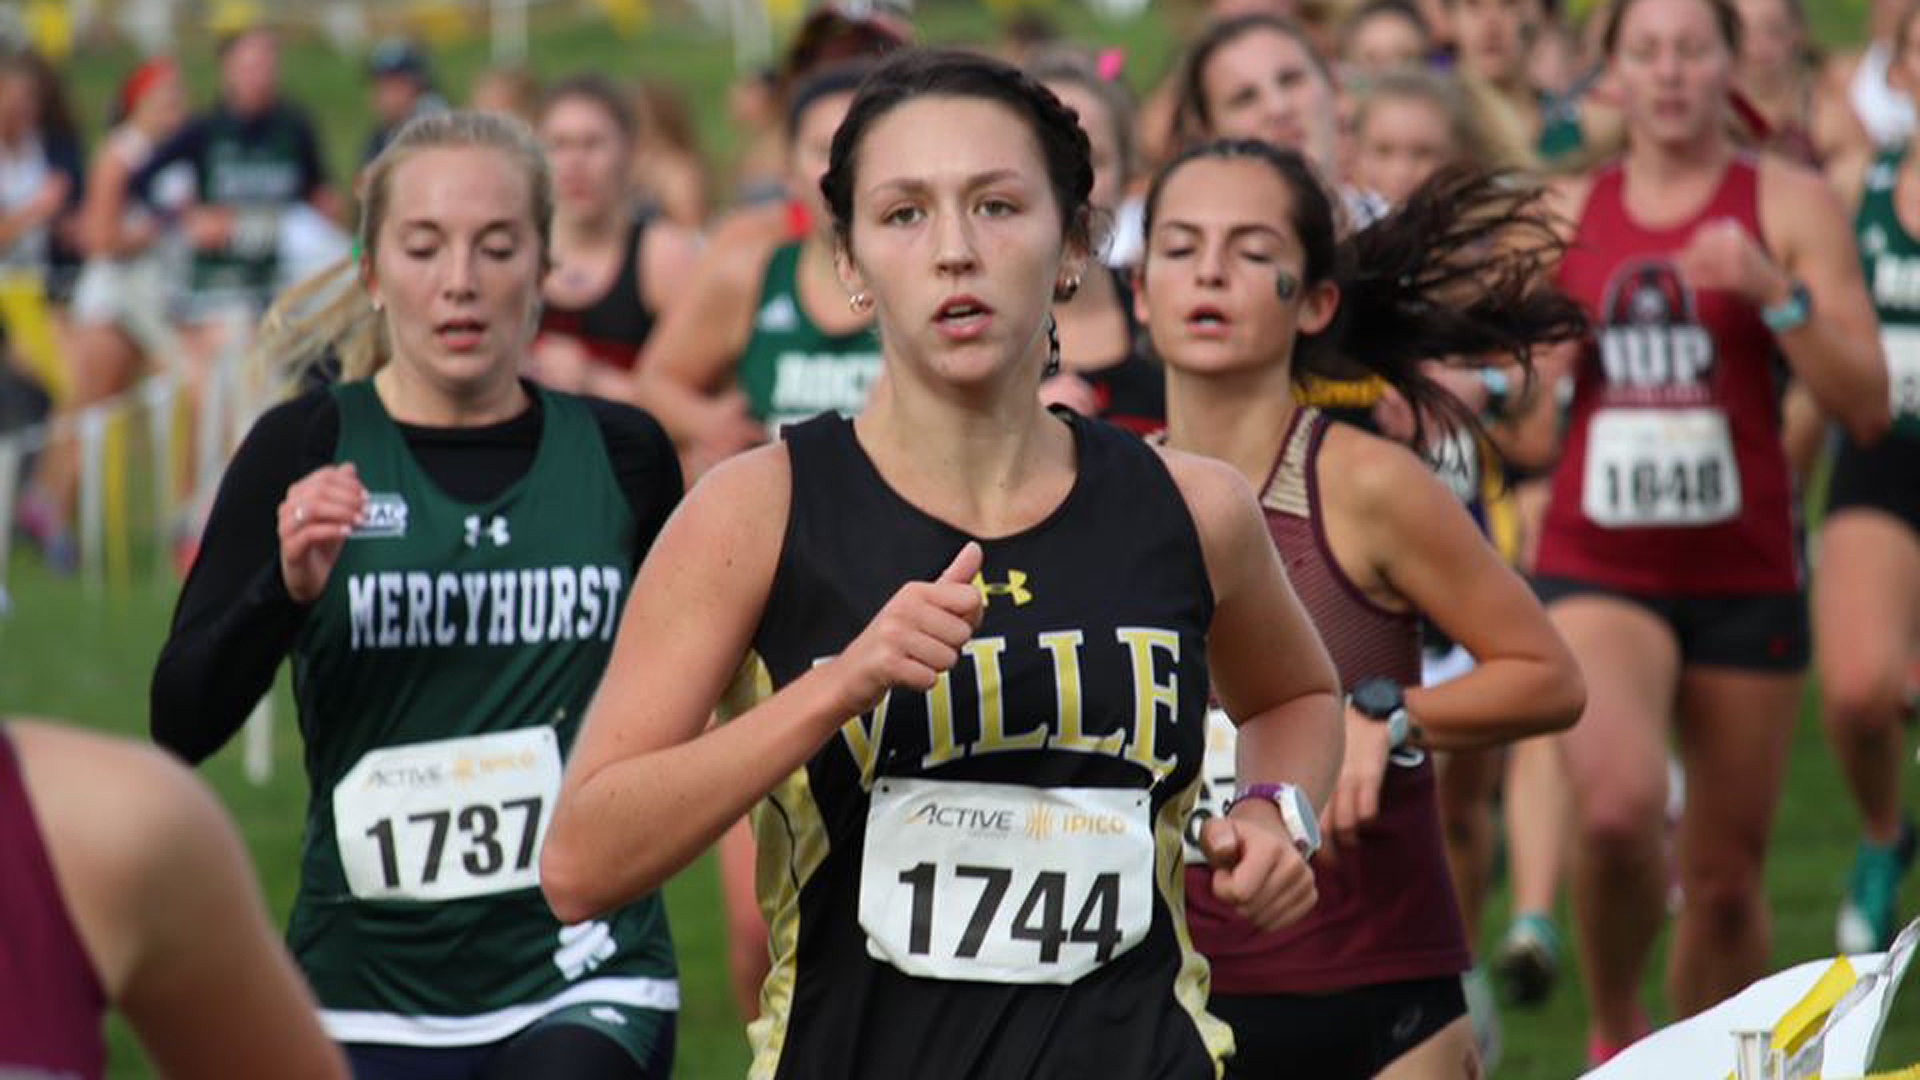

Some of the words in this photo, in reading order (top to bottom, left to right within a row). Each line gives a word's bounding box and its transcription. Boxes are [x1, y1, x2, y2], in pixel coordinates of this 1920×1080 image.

[1602, 325, 1714, 388] IUP
[348, 565, 622, 649] MERCYHURST
[365, 795, 544, 889] 1737
[905, 801, 1014, 833] ACTIVE
[898, 861, 1124, 965] 1744
